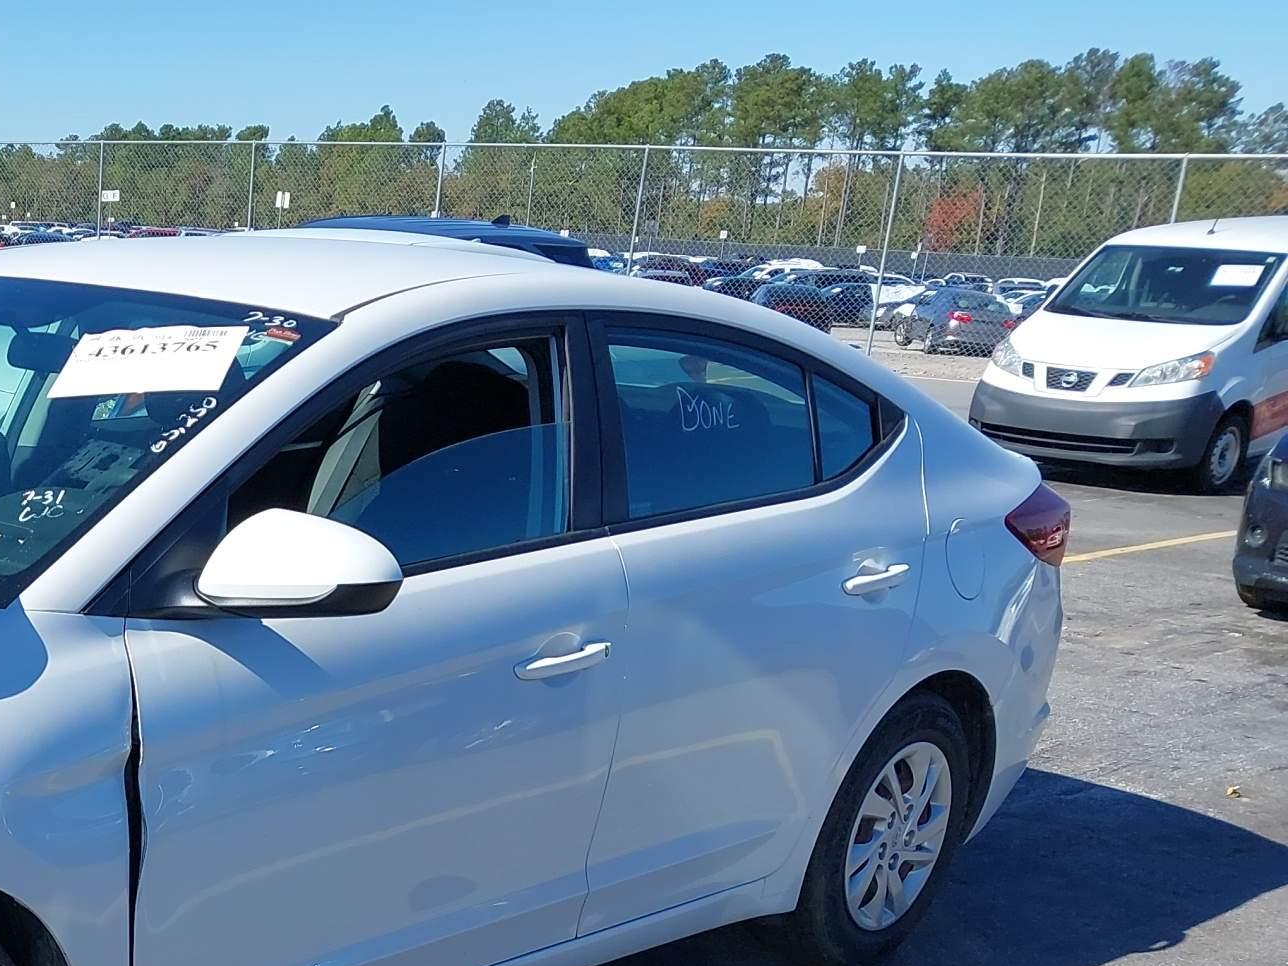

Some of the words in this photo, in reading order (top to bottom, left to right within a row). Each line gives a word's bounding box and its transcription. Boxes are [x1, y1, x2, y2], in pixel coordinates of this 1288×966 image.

[88, 341, 220, 358] 43613765
[676, 386, 740, 432] DONE
[21, 489, 65, 506] 7-31
